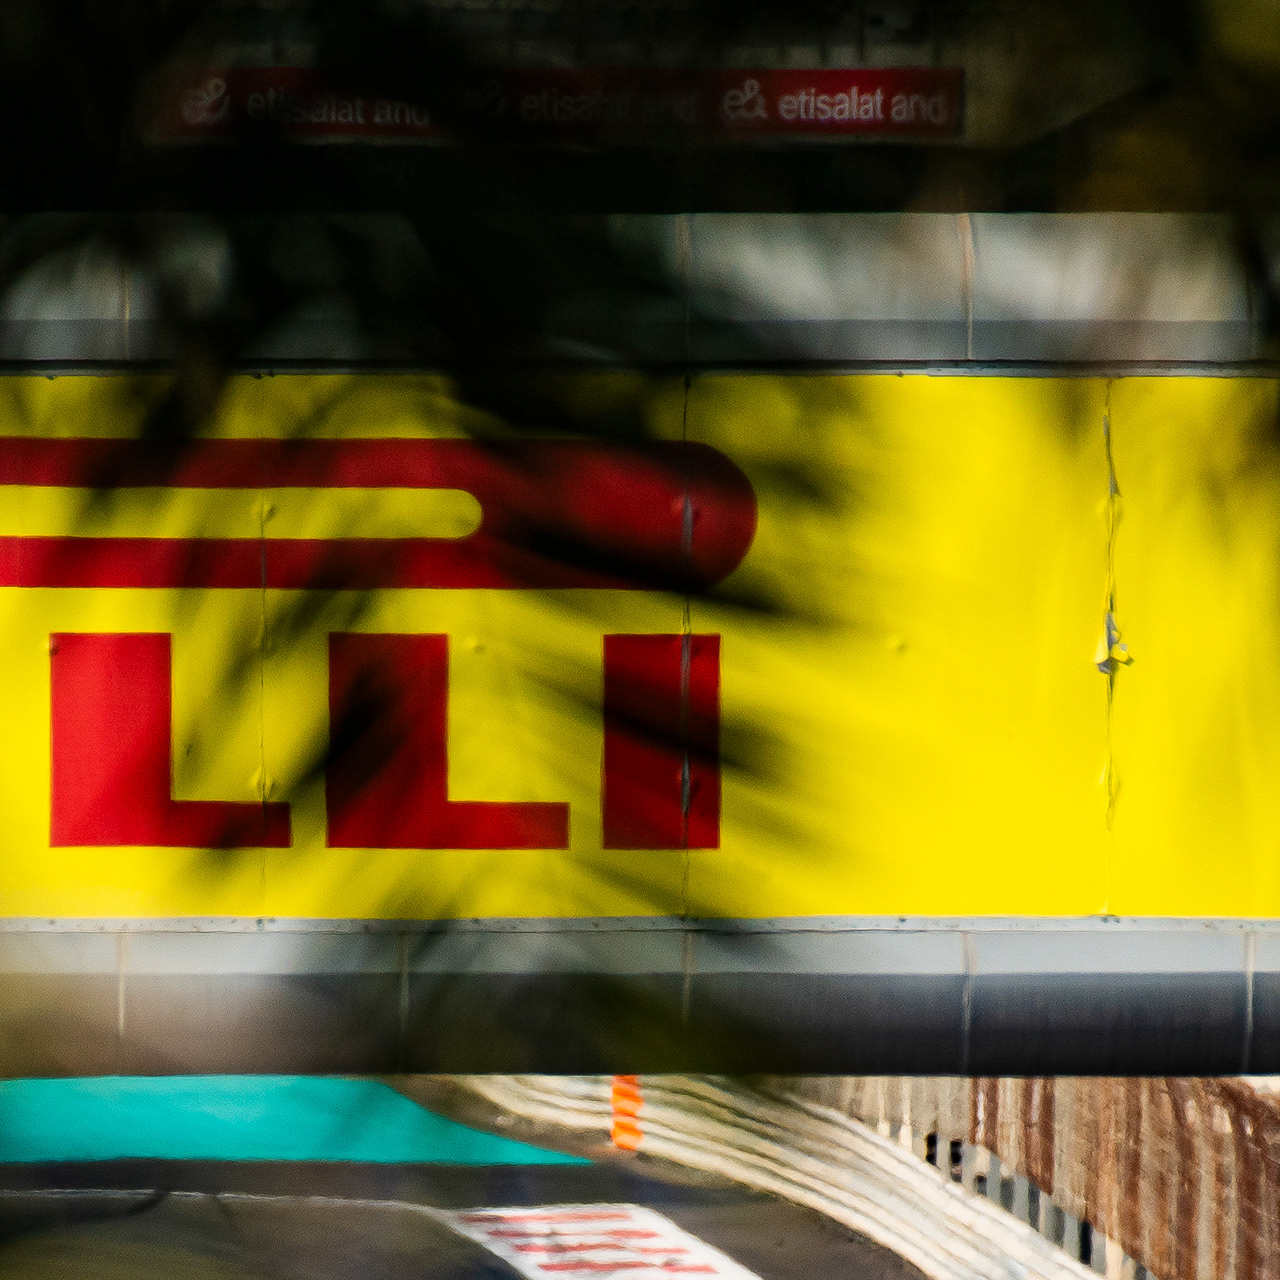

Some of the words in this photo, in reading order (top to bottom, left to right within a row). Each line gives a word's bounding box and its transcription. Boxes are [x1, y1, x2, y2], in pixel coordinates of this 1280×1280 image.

[722, 78, 768, 121] e&
[777, 84, 886, 121] etisalat
[890, 86, 948, 124] and
